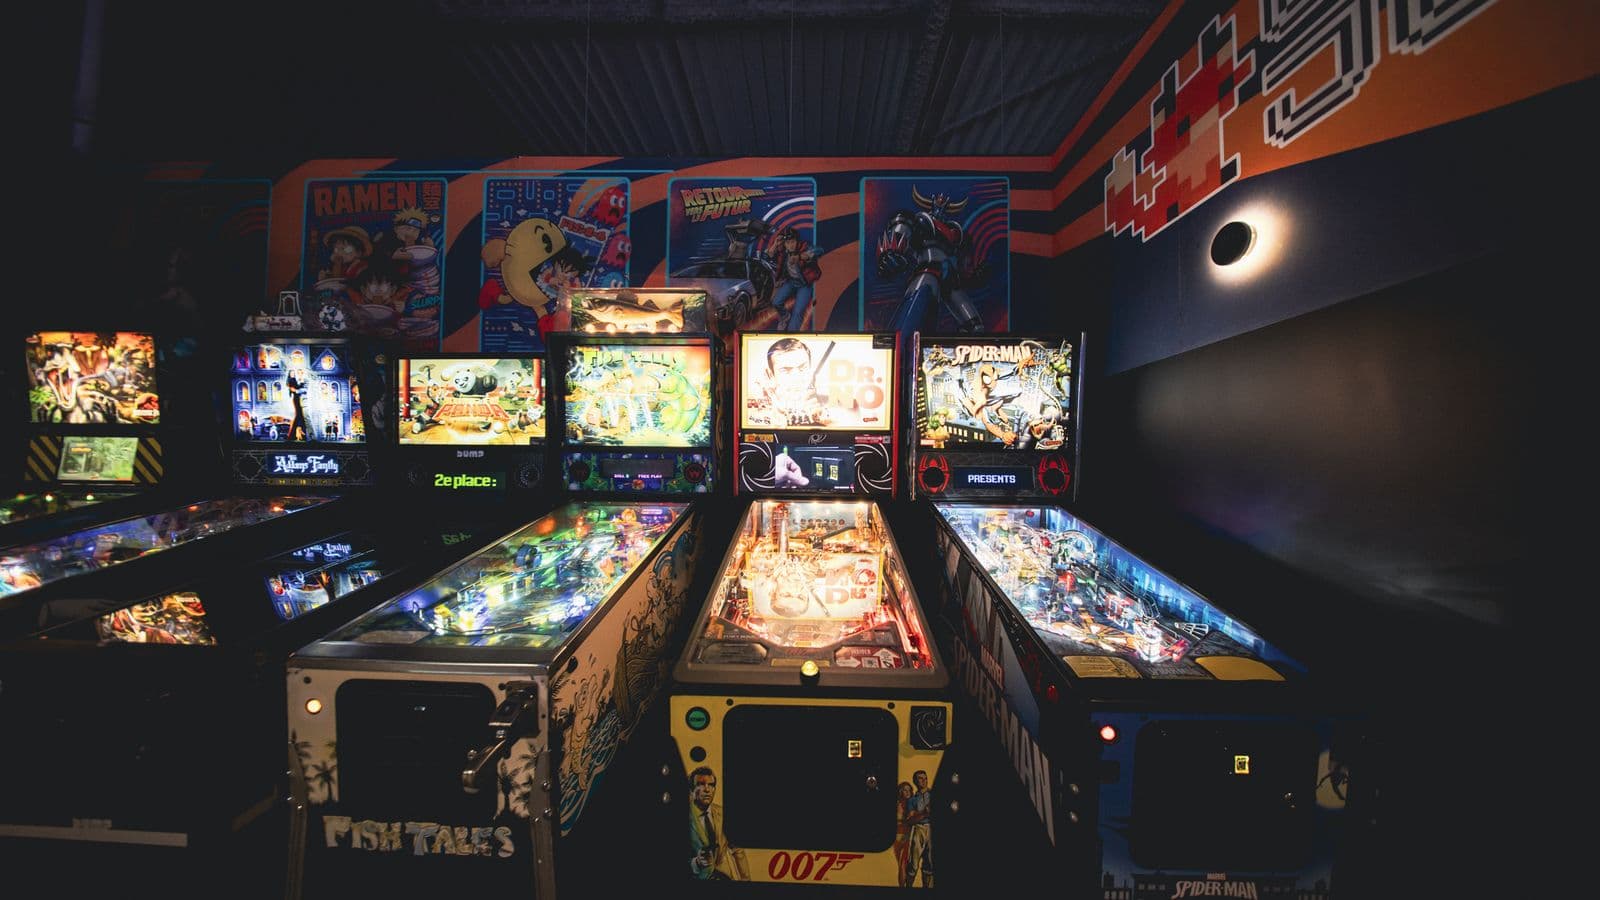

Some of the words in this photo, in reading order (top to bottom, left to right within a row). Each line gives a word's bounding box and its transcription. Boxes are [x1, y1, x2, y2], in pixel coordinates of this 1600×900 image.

[314, 181, 417, 216] RAMEN
[680, 186, 760, 207] RETOUR
[701, 200, 752, 221] FUTUR
[951, 345, 1032, 366] SPIDER-MAN
[306, 454, 339, 474] Family
[434, 473, 452, 487] 2e
[968, 474, 1016, 484] PRESENTS
[322, 815, 401, 852] FISH
[405, 821, 515, 858] TALES
[768, 851, 864, 881] 007
[1171, 881, 1258, 900] SPIDER-MAN
